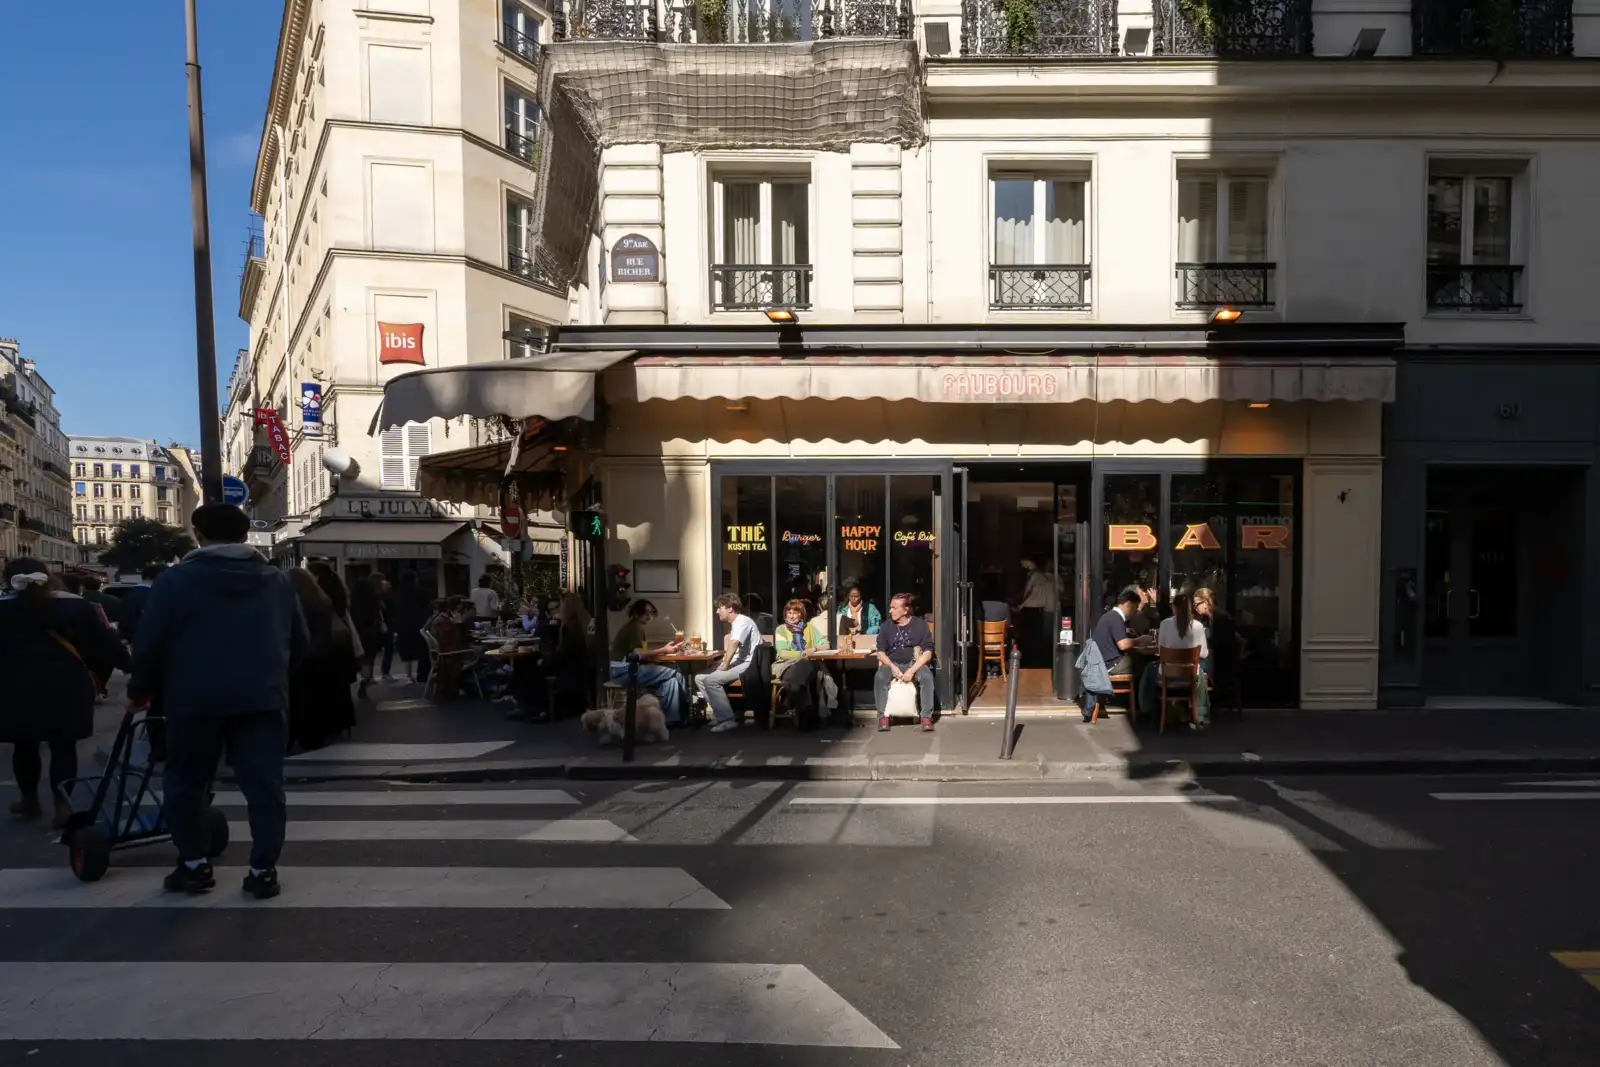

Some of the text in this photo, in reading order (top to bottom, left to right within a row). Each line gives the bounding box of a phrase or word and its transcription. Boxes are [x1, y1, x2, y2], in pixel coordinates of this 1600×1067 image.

[626, 257, 644, 266] RUE
[385, 332, 416, 349] ibis
[942, 373, 1057, 396] FAUBOURG
[268, 416, 289, 460] TABAC
[347, 500, 371, 515] LE
[379, 500, 462, 516] JULYANN
[727, 522, 766, 542] THÉ
[781, 530, 822, 546] Burger
[841, 525, 881, 538] HAPPY
[894, 530, 937, 546] Café Bio
[727, 542, 768, 551] KUSMI TEA
[845, 539, 877, 551] HOUR
